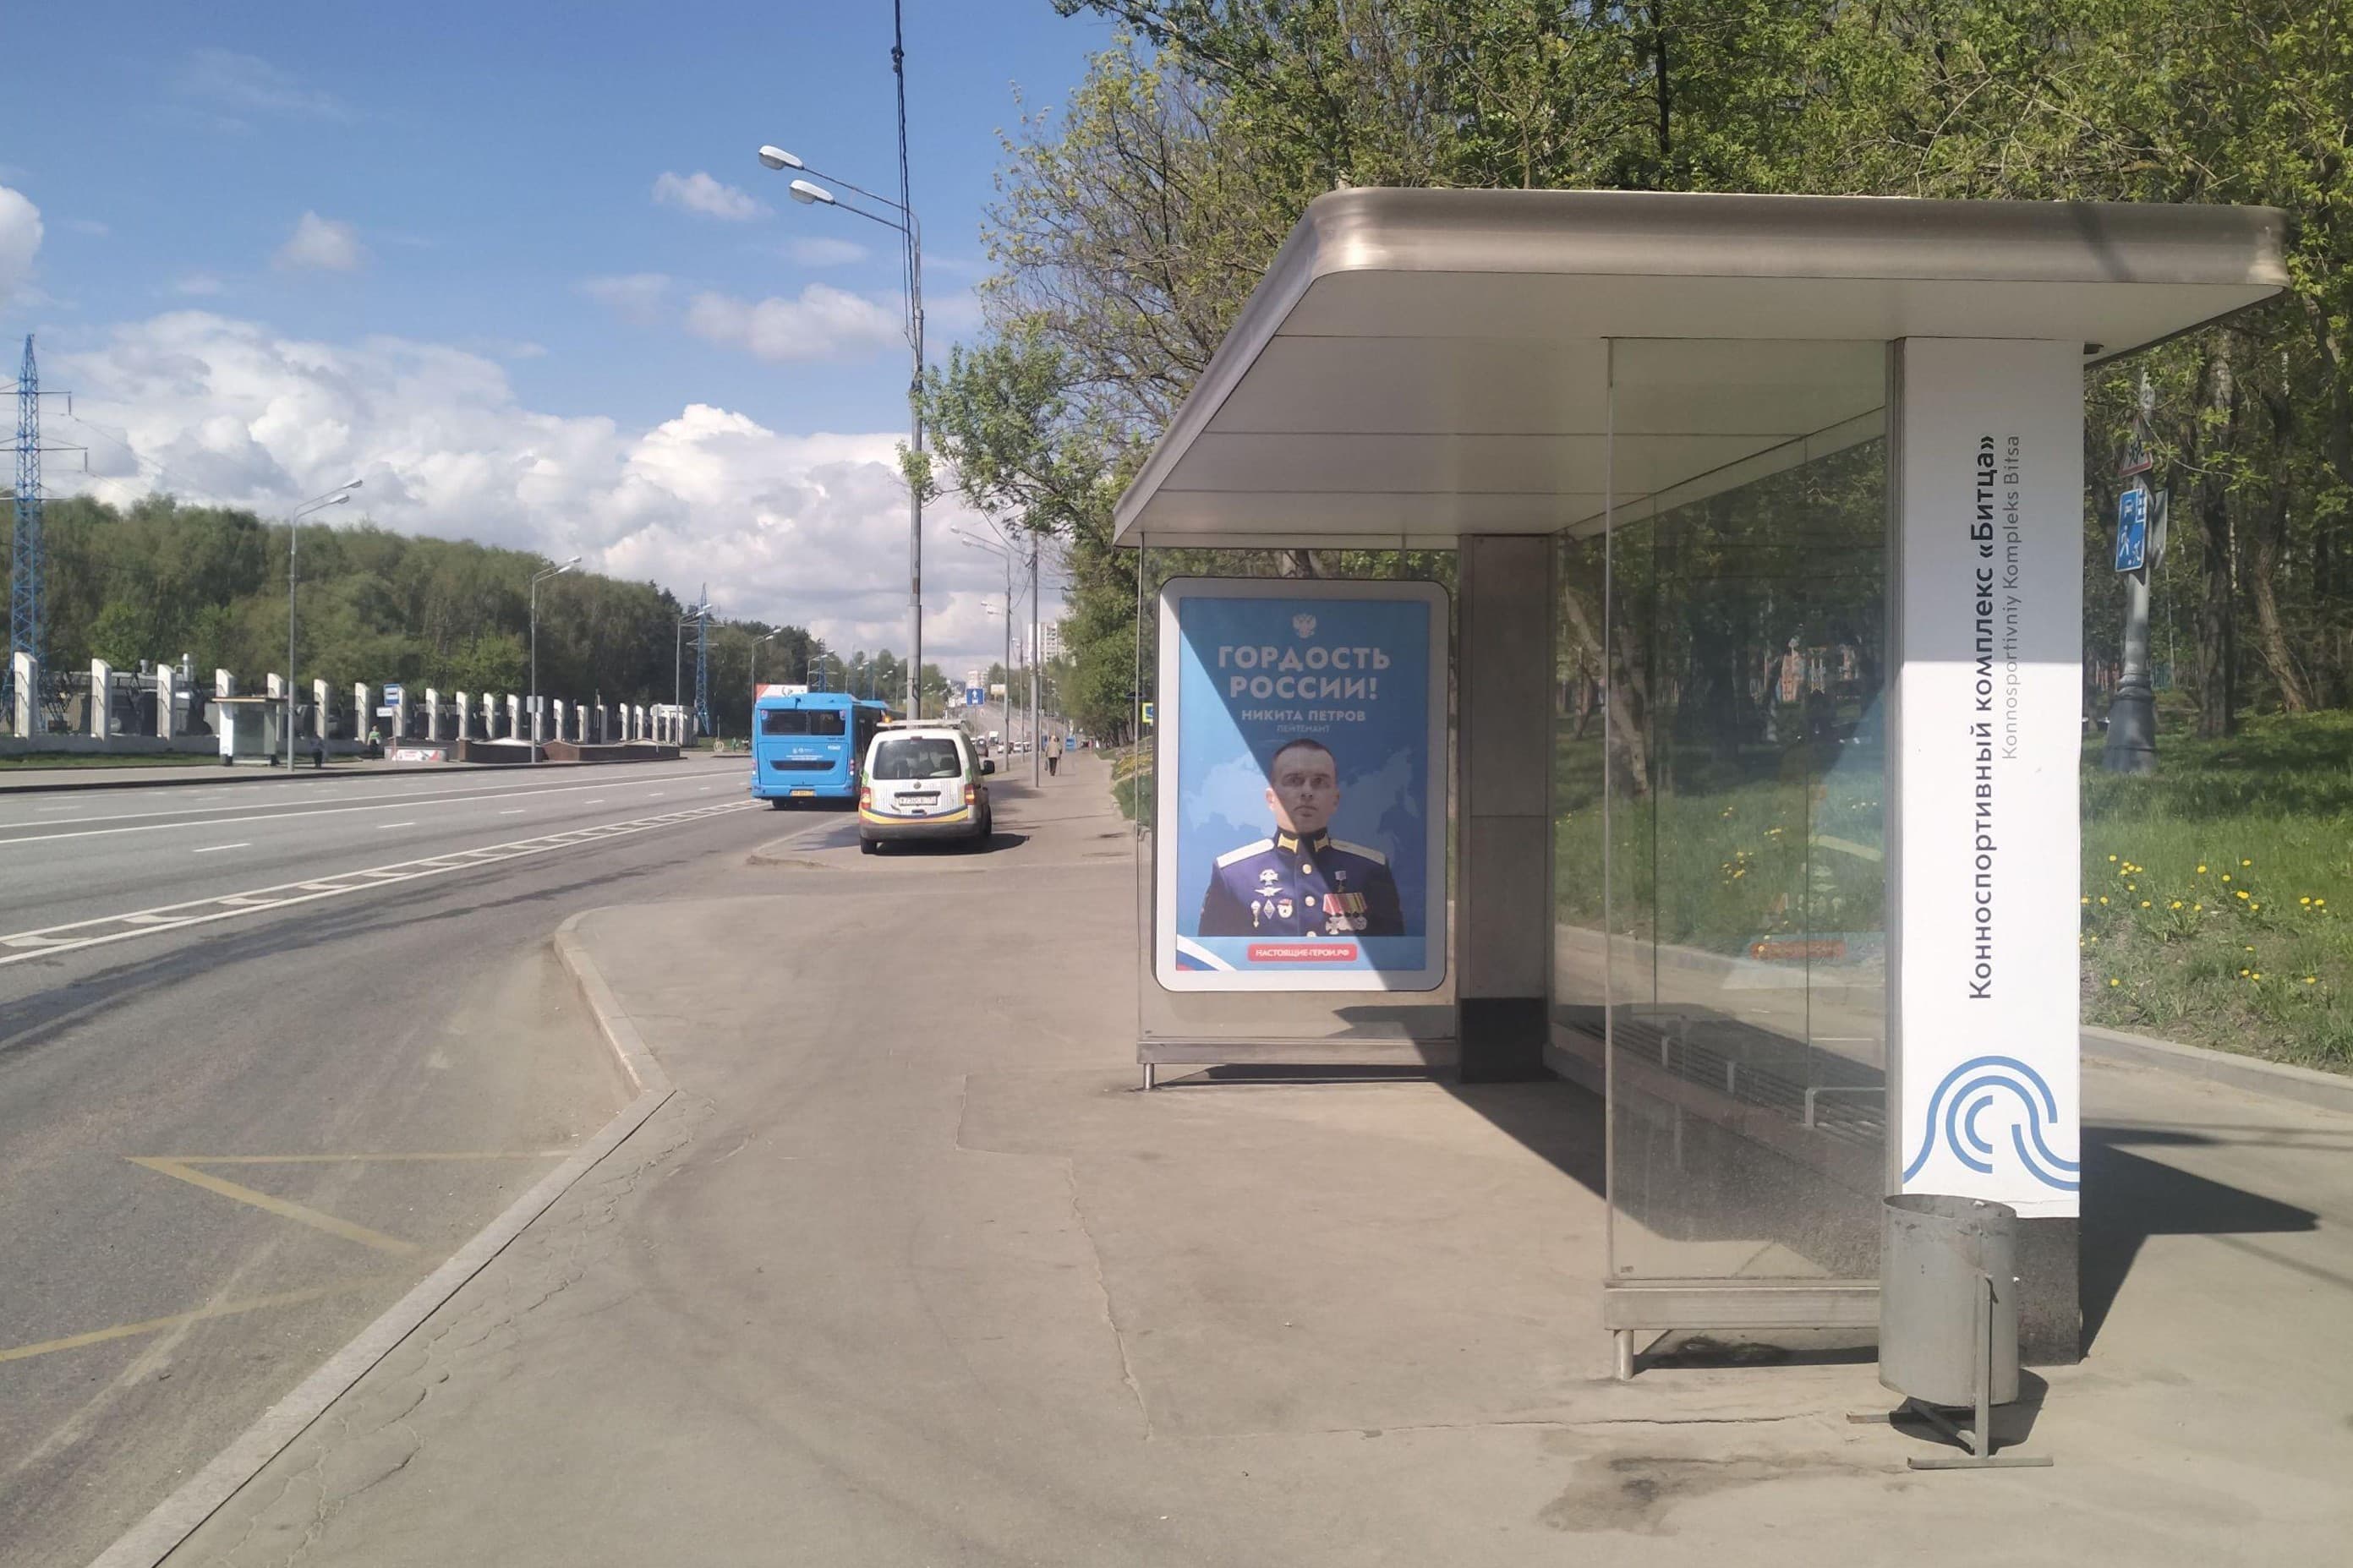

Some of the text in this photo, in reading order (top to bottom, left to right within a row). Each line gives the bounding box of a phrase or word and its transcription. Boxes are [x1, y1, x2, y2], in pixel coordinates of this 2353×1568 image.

[2001, 435, 2022, 758] Konnosportivniy Kompleks Bitsa
[1218, 645, 1392, 672] ГОРДОСТЬ
[1230, 675, 1378, 701] РОССИИ!
[1242, 709, 1366, 722] НИКИТА ПЕТРОВ
[1968, 434, 1998, 999] Конноспортивный комплекс «Битца»
